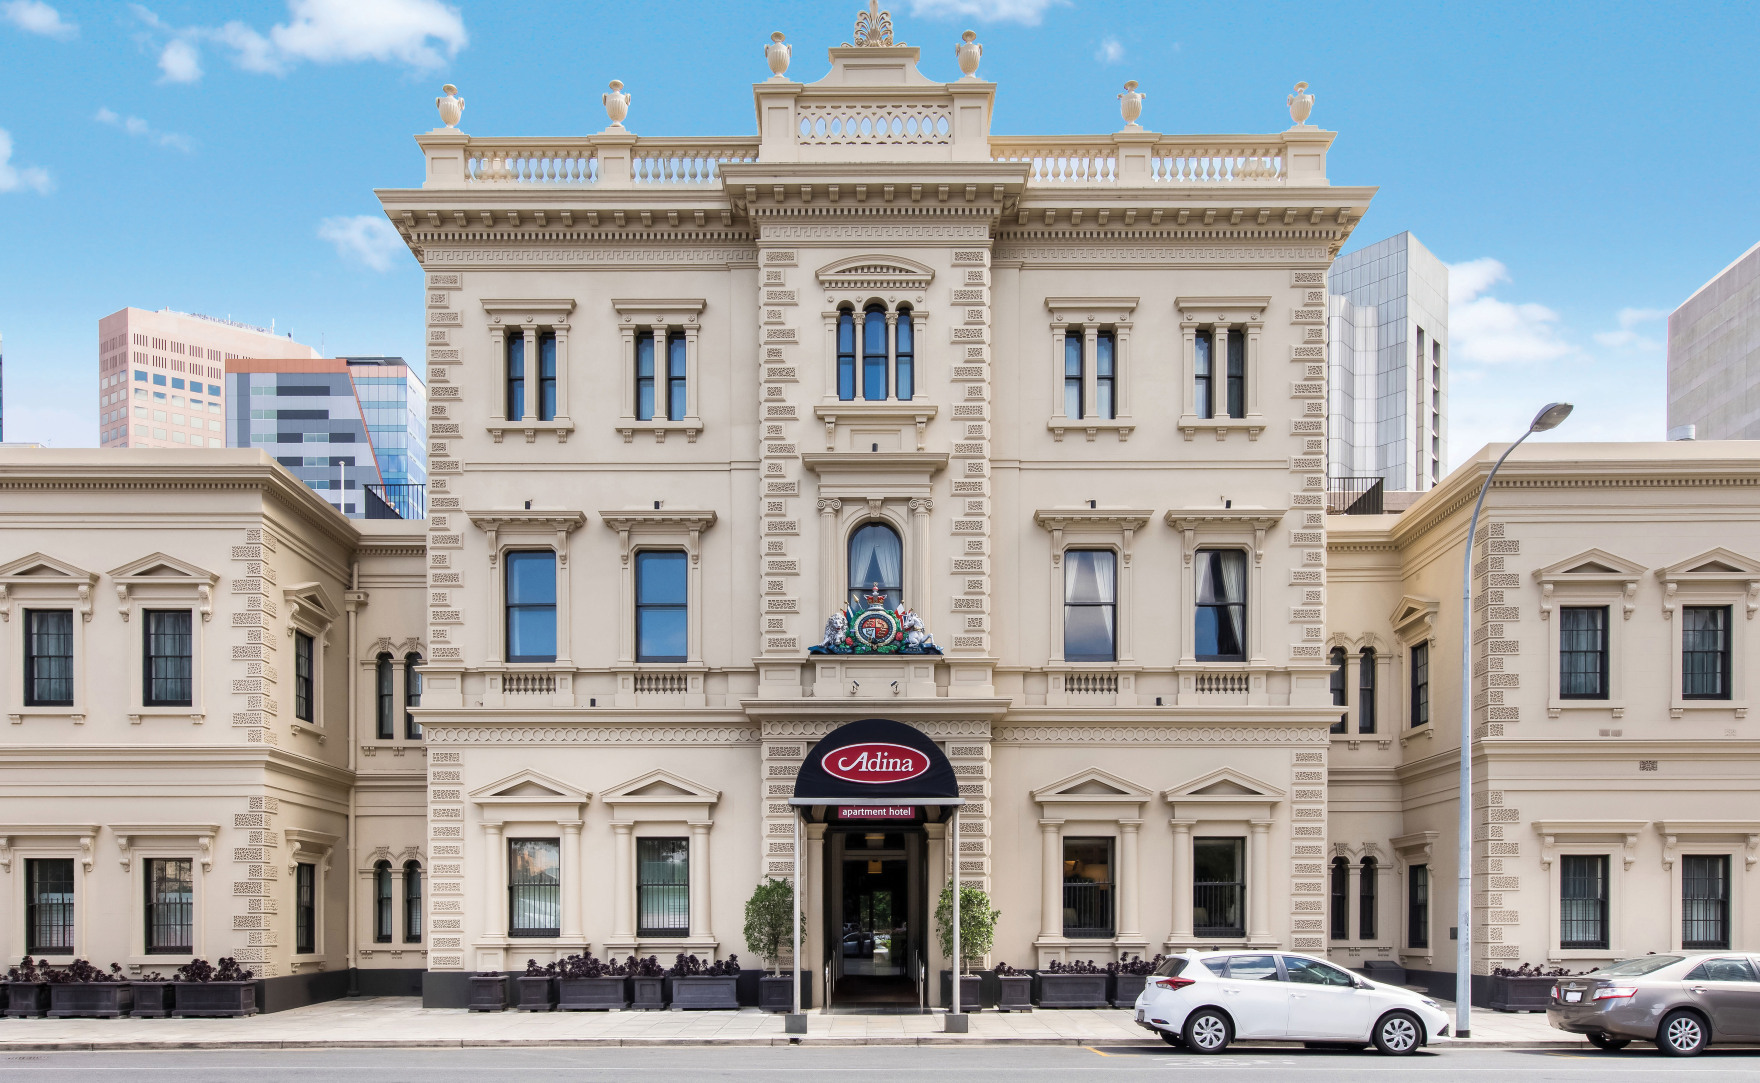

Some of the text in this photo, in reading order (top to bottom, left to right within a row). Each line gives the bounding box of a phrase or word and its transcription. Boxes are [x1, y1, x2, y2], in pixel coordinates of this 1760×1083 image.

[838, 752, 914, 772] Adina
[842, 806, 911, 818] apartment hotel
